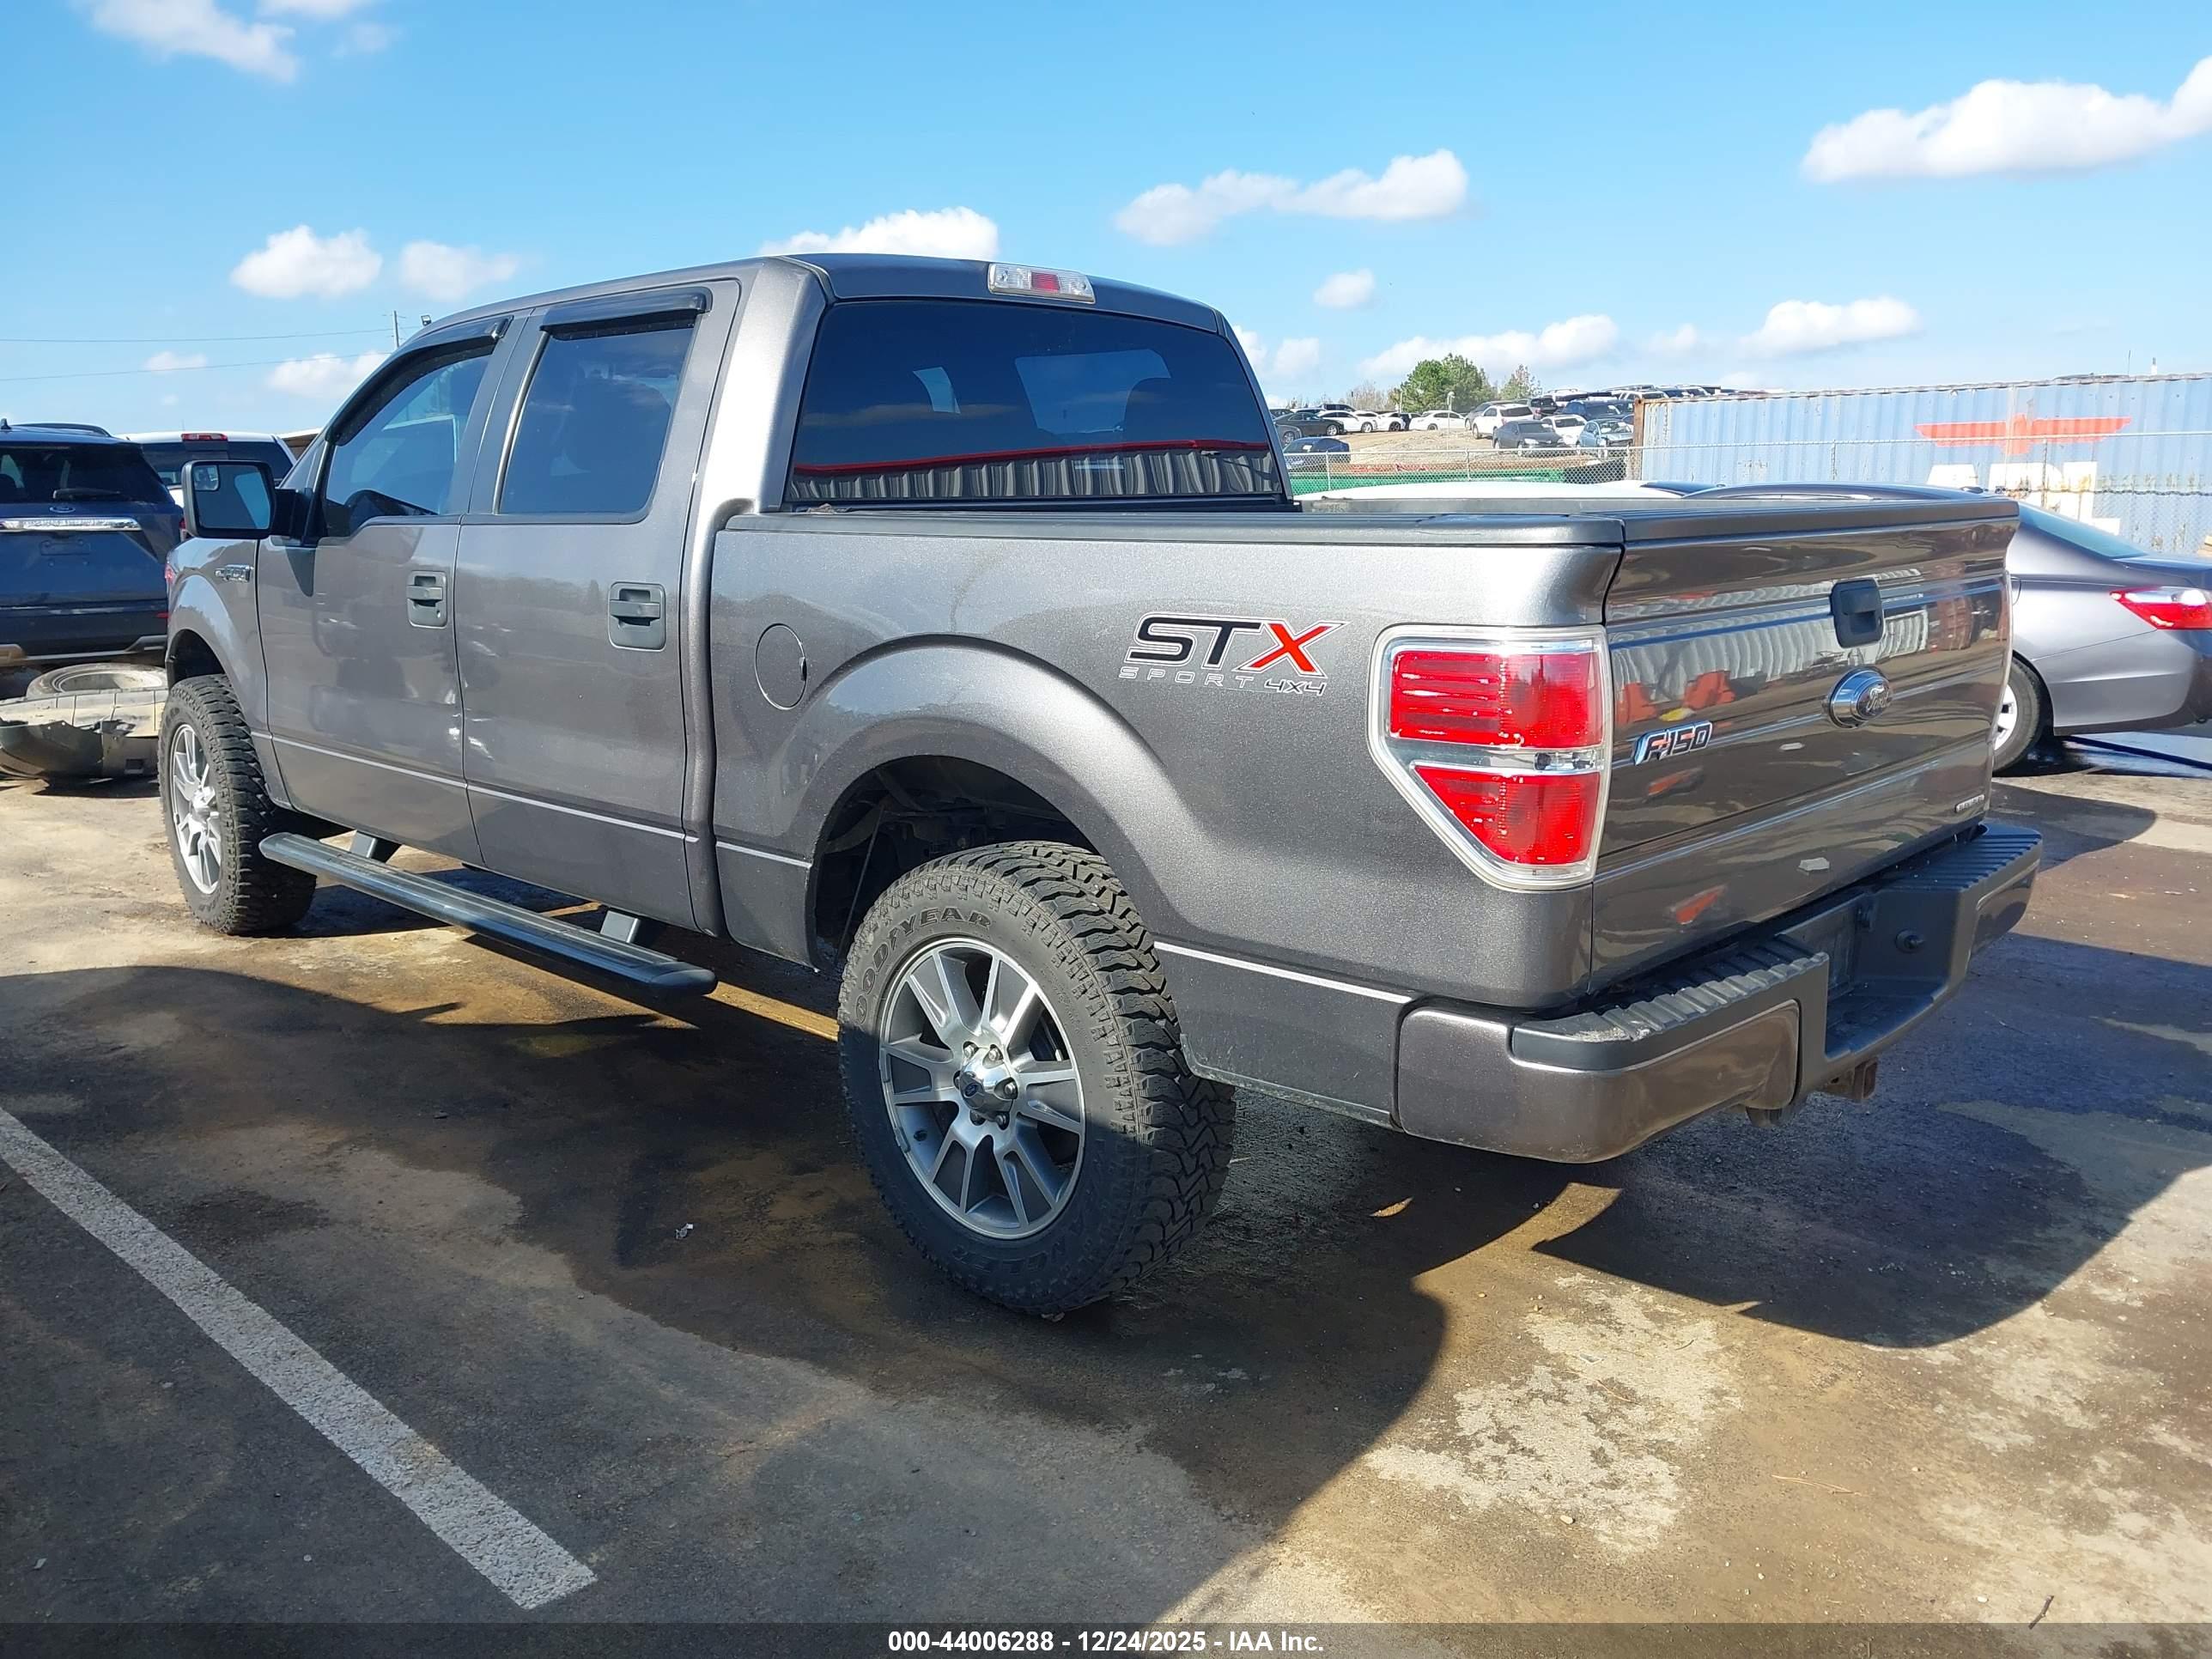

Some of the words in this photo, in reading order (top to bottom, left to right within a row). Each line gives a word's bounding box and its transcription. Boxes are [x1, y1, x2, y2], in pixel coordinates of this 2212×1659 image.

[1926, 461, 2120, 536] PL
[1119, 666, 1254, 688] SPORT
[1124, 612, 1348, 678] STX
[856, 907, 992, 1032] OODYEAR
